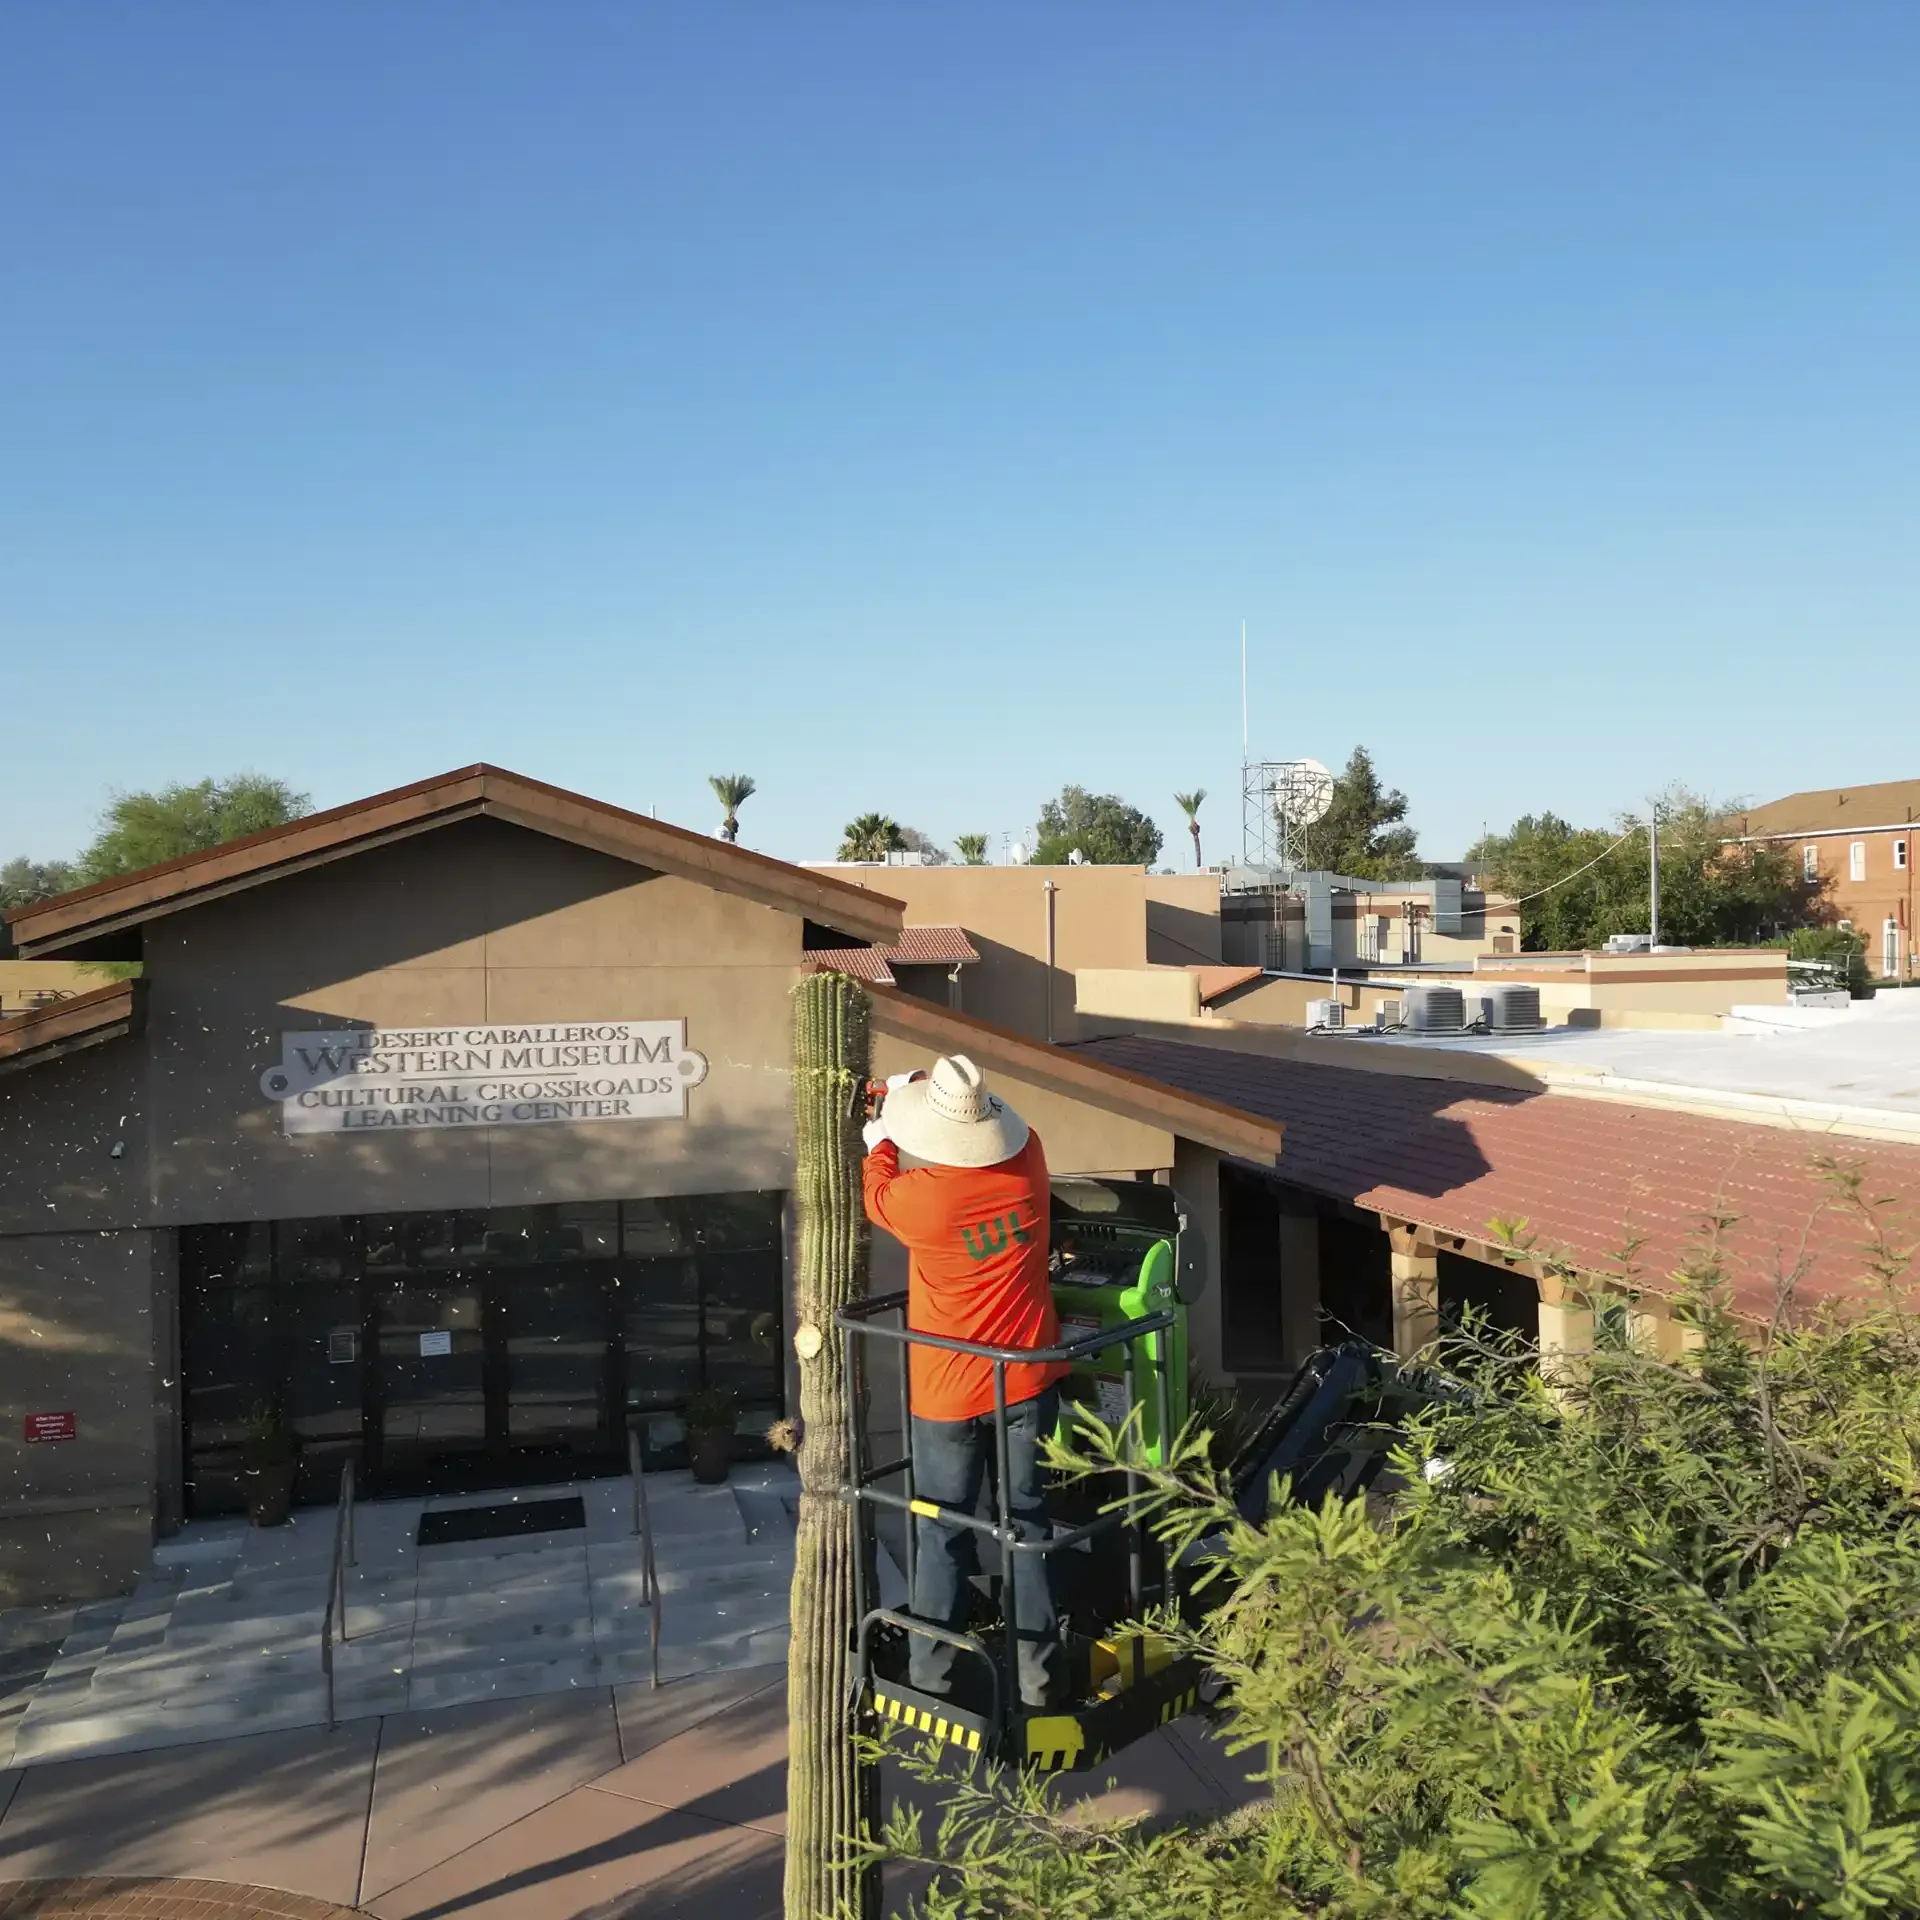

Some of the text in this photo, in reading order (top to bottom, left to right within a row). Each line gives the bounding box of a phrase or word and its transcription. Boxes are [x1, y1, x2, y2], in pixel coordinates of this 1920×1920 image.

[357, 1025, 630, 1049] DESERT CABALLEROS
[295, 1036, 675, 1075] WESTERN MUSEUM
[297, 1076, 673, 1108] CULTURAL CROSSROADS
[342, 1099, 632, 1128] LEARNING CENTER
